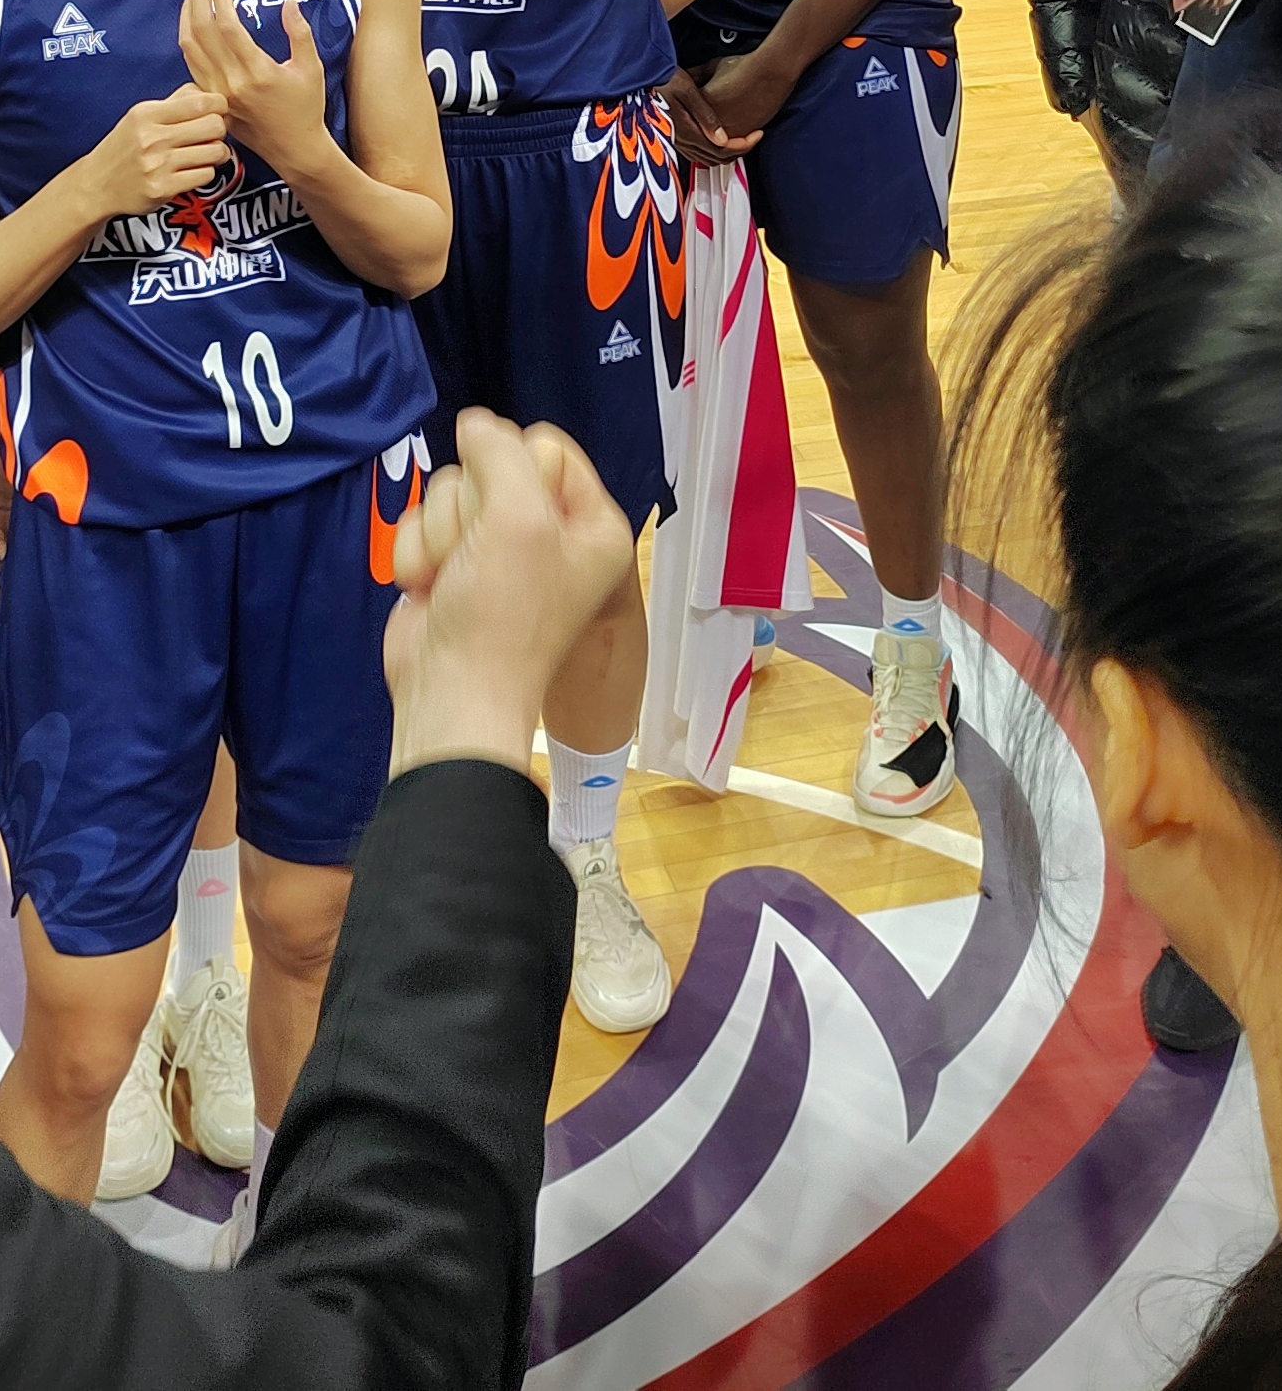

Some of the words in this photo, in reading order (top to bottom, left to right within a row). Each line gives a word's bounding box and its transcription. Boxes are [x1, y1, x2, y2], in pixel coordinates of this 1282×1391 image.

[42, 29, 110, 62] PEAK
[856, 72, 900, 98] PEAK
[599, 337, 642, 364] PEAK
[202, 331, 294, 449] 10
